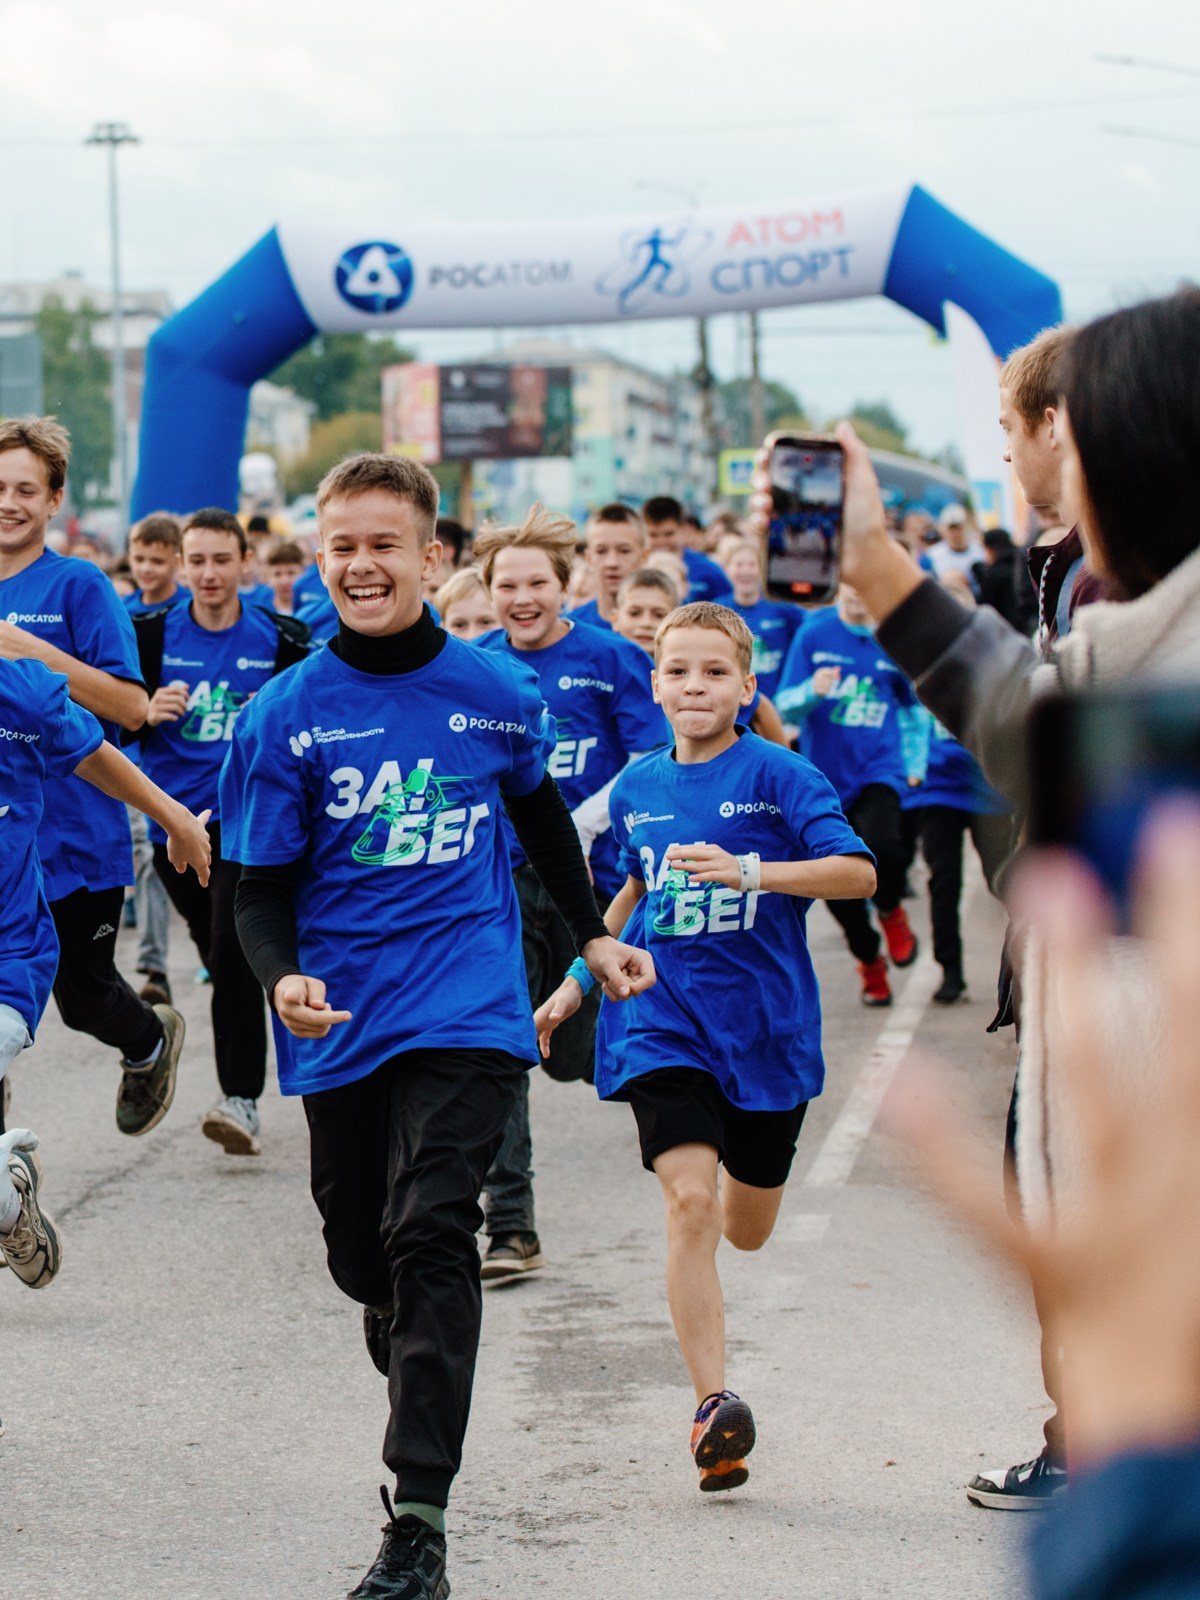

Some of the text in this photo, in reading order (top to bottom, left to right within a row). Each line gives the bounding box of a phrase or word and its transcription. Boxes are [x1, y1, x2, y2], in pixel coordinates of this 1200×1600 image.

[726, 209, 846, 249] АТОМ
[428, 259, 573, 290] РОСАТОМ
[710, 245, 855, 294] СПОРТ
[18, 613, 63, 623] РОСАТОМ
[572, 676, 614, 692] РОСАТОМ
[470, 717, 527, 735] РОСАТОМ
[548, 736, 598, 779] ЕГ
[324, 757, 434, 820] ЗА!
[382, 802, 490, 867] БЕГ
[673, 886, 772, 936] БЕГ
